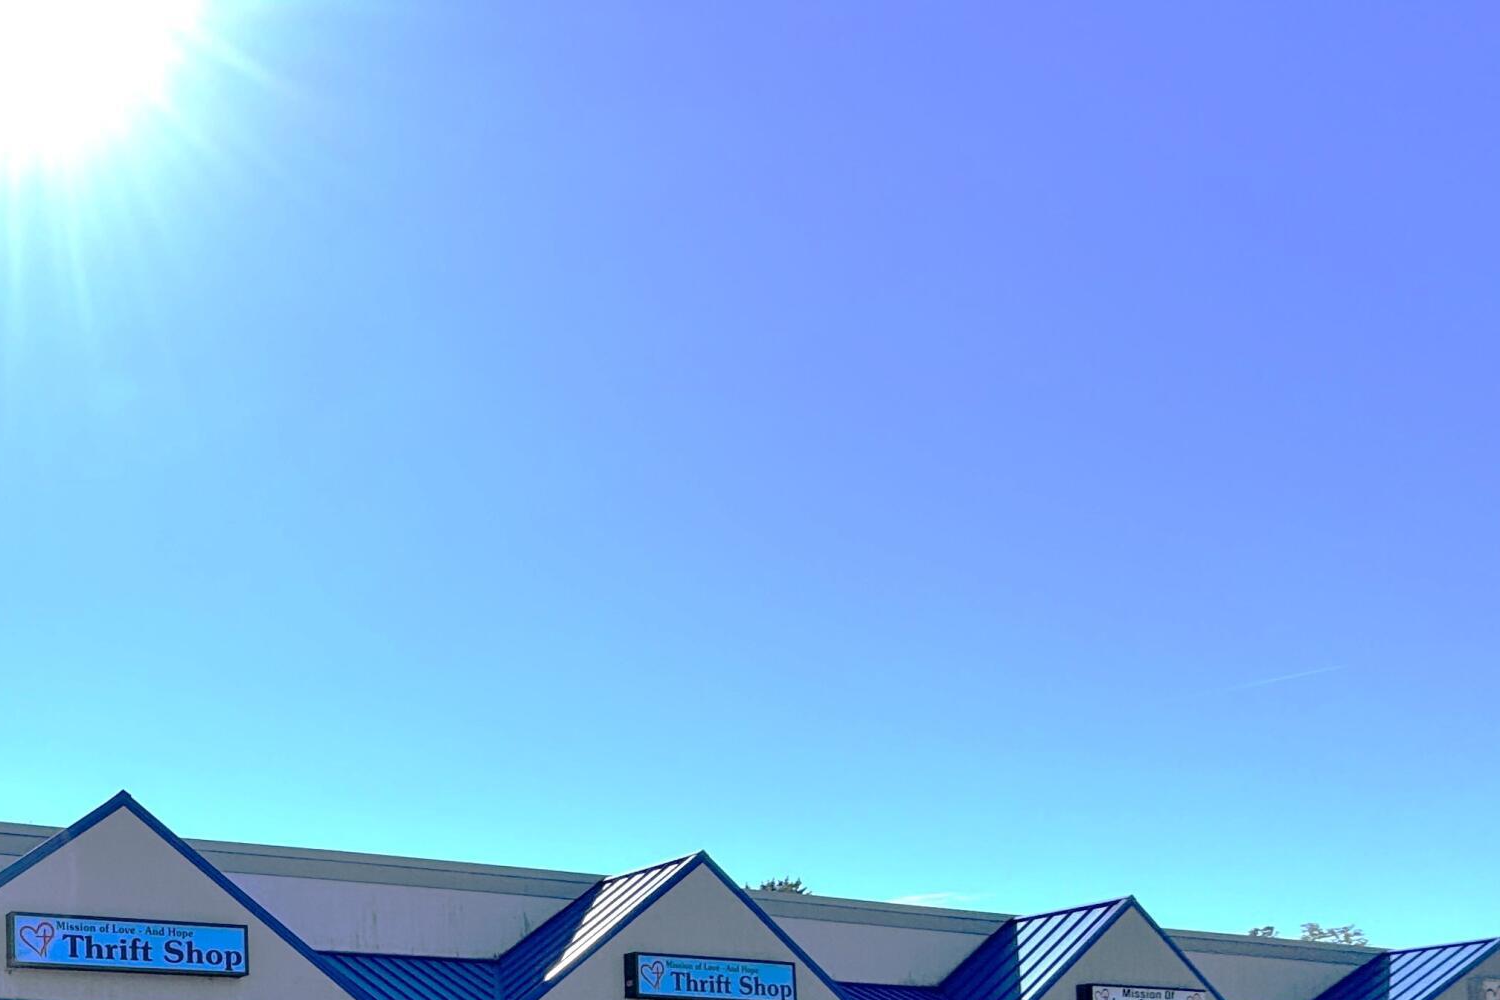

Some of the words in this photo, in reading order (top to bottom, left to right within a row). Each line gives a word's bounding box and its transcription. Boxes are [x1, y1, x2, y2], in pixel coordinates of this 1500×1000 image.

[56, 920, 96, 932] Mission
[99, 924, 110, 933] of
[112, 924, 135, 934] Love
[145, 926, 165, 937] And
[168, 928, 194, 939] Hope
[62, 934, 153, 962] Thrift
[163, 939, 242, 971] Shop
[671, 971, 732, 994] Thrift
[739, 975, 792, 1000] Shop
[1122, 988, 1162, 999] Mission
[1165, 991, 1175, 1000] Of
